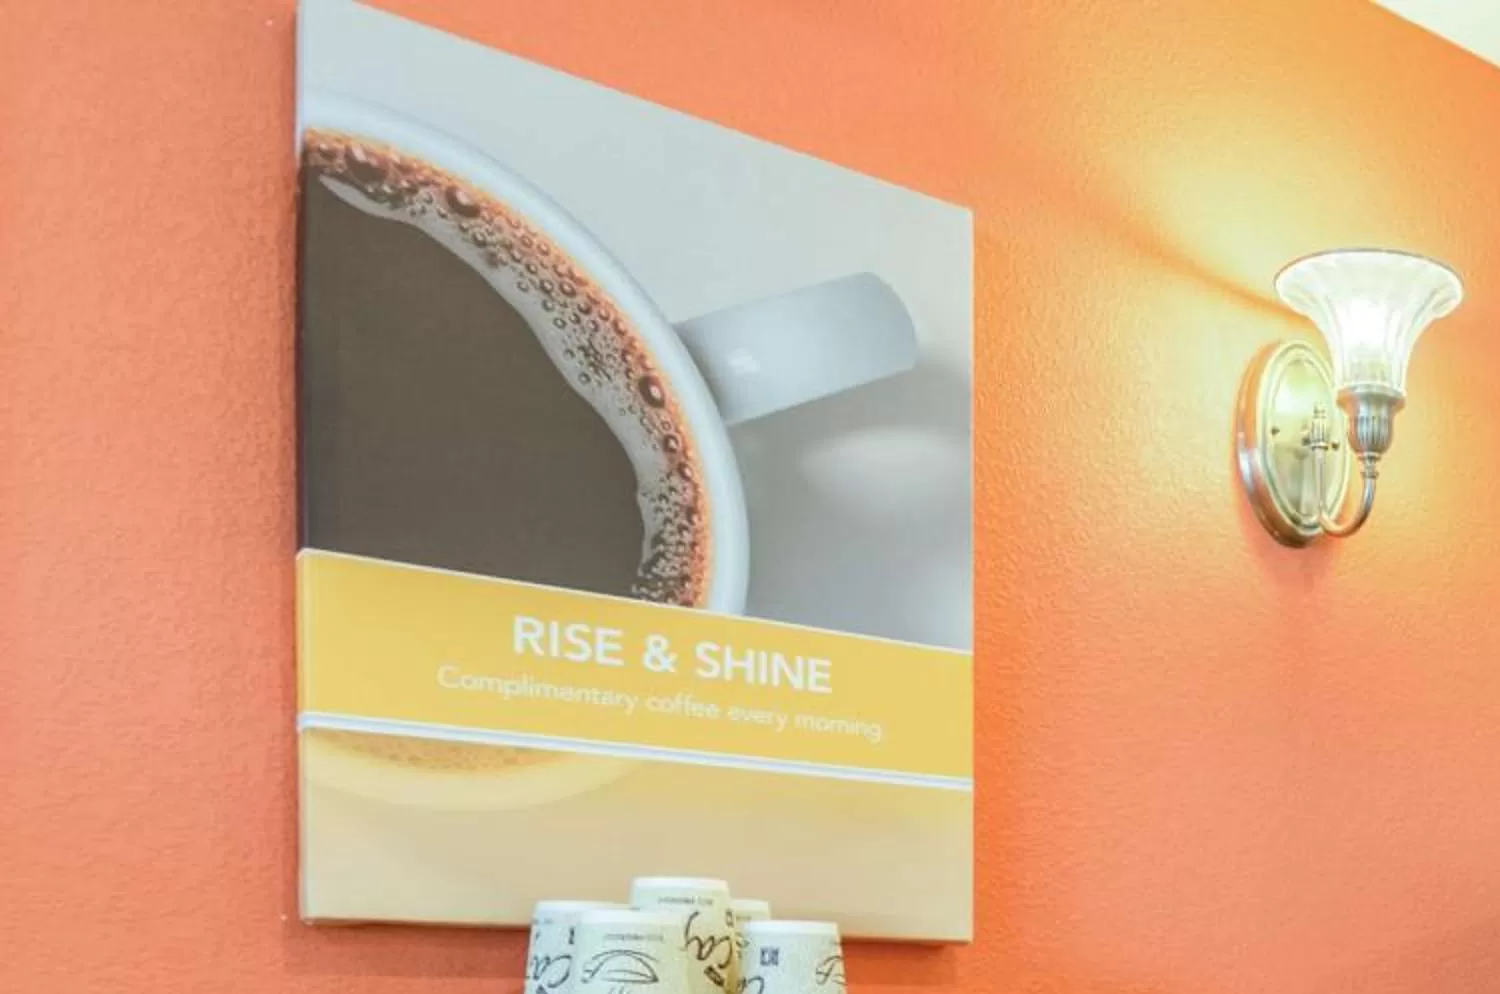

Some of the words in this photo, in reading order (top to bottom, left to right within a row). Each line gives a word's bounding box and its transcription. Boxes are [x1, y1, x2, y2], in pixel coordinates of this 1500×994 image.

[512, 614, 625, 667] RISE
[642, 632, 679, 673] &
[695, 641, 833, 694] SHINE
[436, 663, 639, 716] Complimentary
[646, 690, 720, 719] coffee
[727, 704, 788, 733] every
[794, 711, 882, 743] morning
